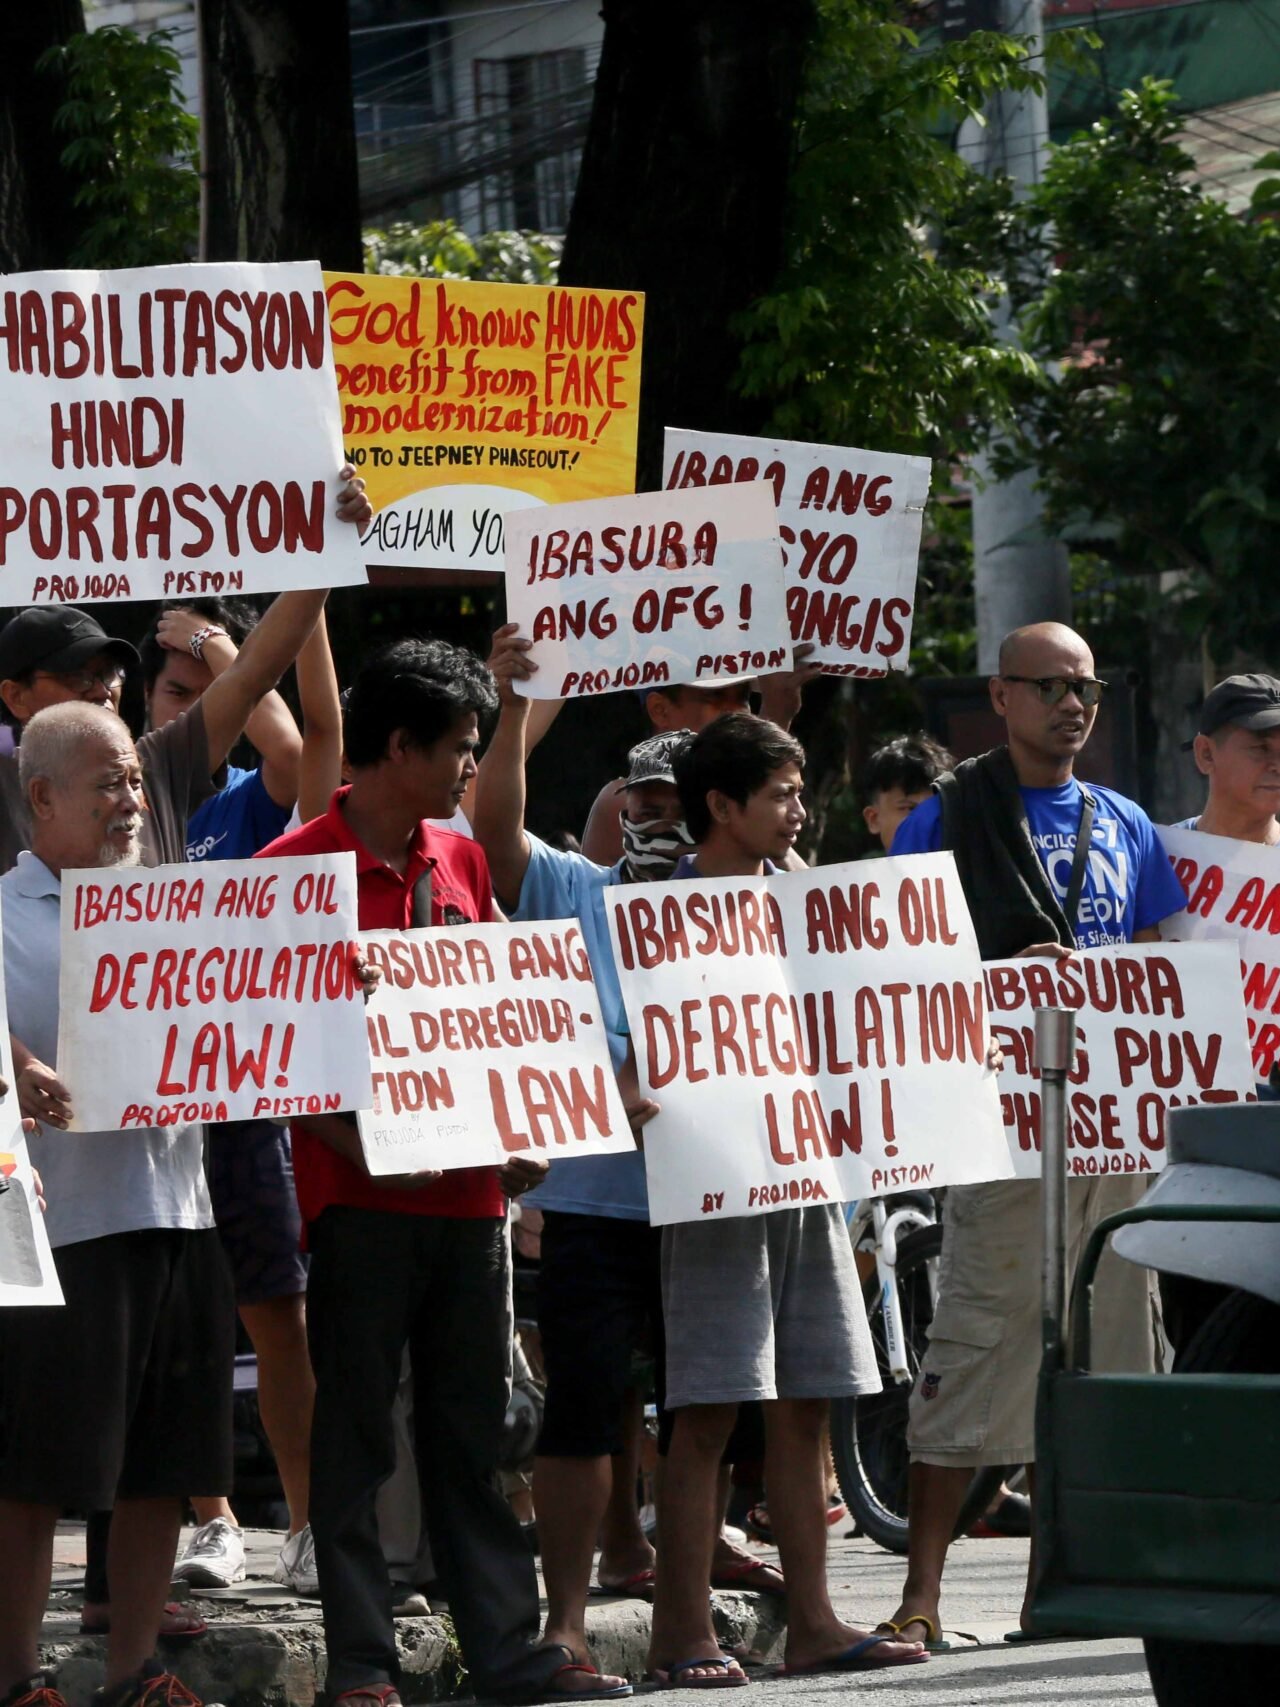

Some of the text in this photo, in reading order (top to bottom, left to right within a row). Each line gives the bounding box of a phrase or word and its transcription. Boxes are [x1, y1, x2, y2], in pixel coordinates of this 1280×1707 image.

[327, 280, 637, 352] God knows HUDAS
[458, 349, 537, 398] from
[545, 352, 629, 409] FAKE
[51, 397, 184, 470] HINDI
[343, 395, 612, 445] modernization!
[369, 446, 393, 467] TO
[398, 445, 484, 467] JEEPNEY
[489, 448, 580, 471] PHASEOUT!
[799, 466, 892, 517] ANG
[361, 508, 505, 558] AGHAM YO
[527, 521, 719, 586] IBASURA
[33, 570, 243, 602] PROJODA PISTON
[533, 598, 617, 644] ANG
[560, 647, 787, 698] PROJODA PISTON
[74, 873, 339, 931] IBASURA ANG OIL
[615, 877, 959, 971] IBASURA ANG OIL
[508, 928, 595, 984] ANG
[156, 1021, 295, 1096] LAW!
[642, 981, 985, 1090] DEREGULATION
[1114, 1026, 1222, 1089] PUV
[253, 1093, 342, 1117] PISTON
[436, 1121, 470, 1137] PISTON
[488, 1064, 614, 1152] LAW
[748, 1177, 829, 1208] PROJODA
[872, 1163, 934, 1190] PISTON
